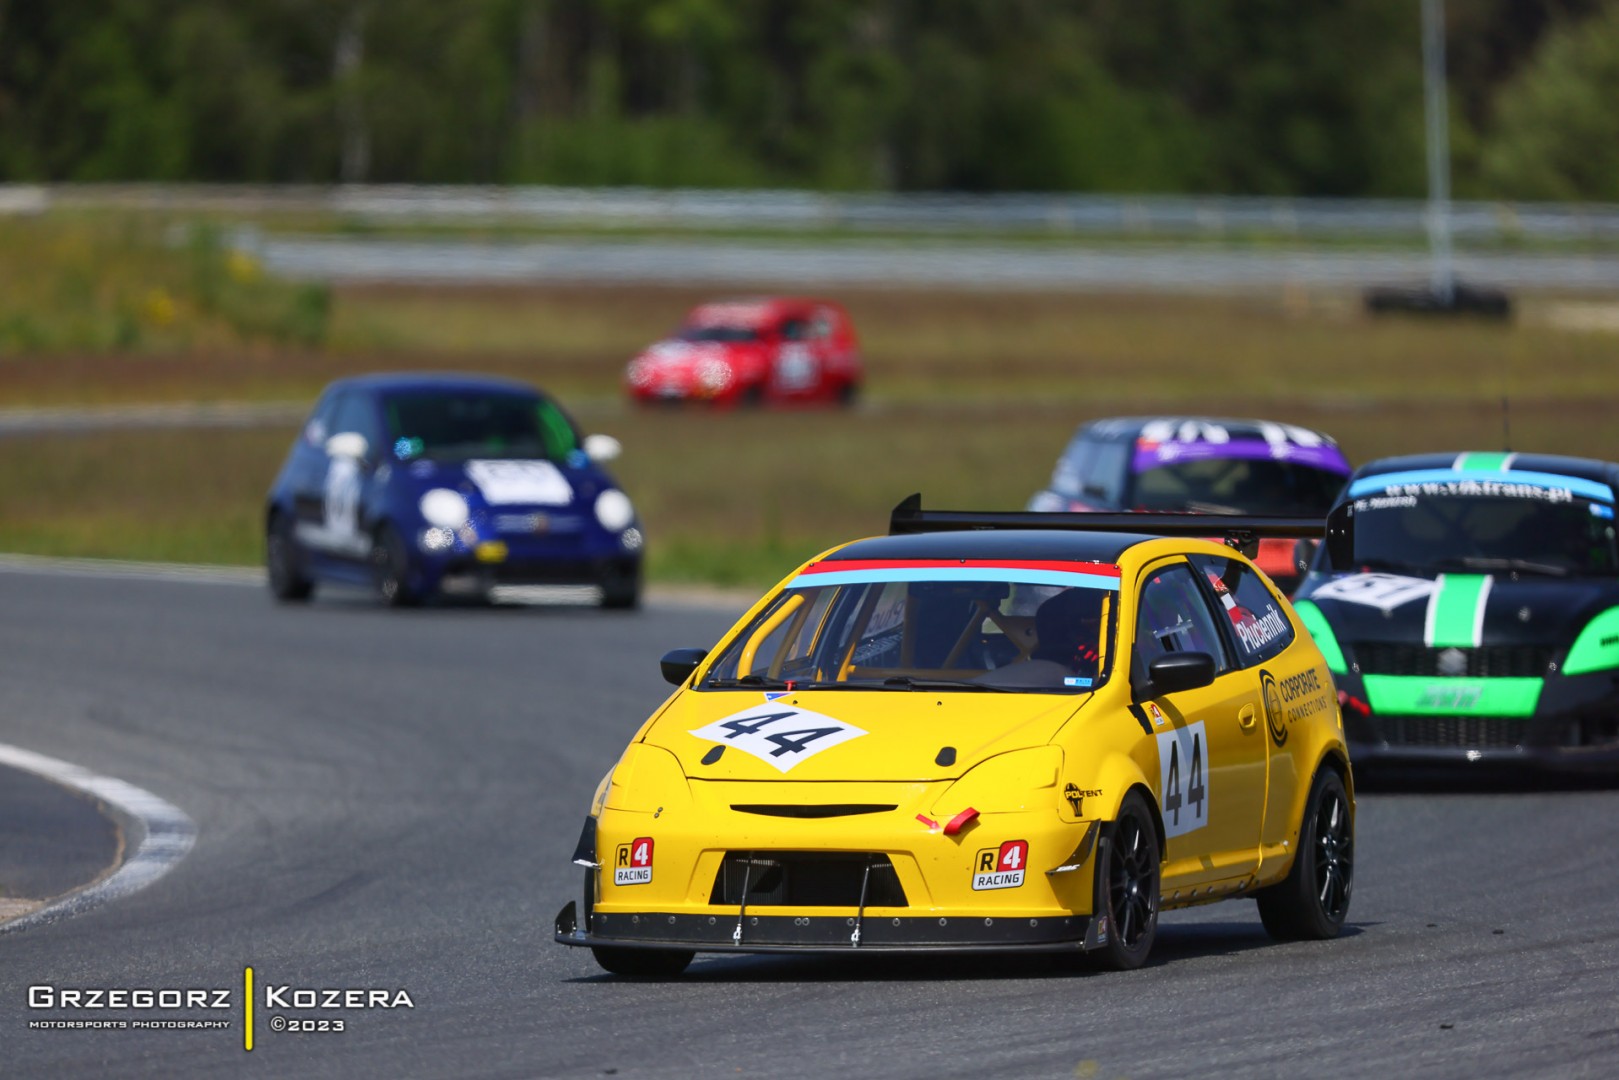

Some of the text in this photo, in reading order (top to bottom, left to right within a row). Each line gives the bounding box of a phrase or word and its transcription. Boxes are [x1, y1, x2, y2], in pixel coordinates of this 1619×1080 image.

[1280, 668, 1321, 703] CORPORATE
[1287, 696, 1328, 723] CONNECTIONS
[719, 711, 845, 757] 44
[1165, 733, 1205, 826] 44
[1065, 789, 1103, 799] POLTENT
[618, 870, 648, 881] RACING
[978, 873, 1019, 886] RACING
